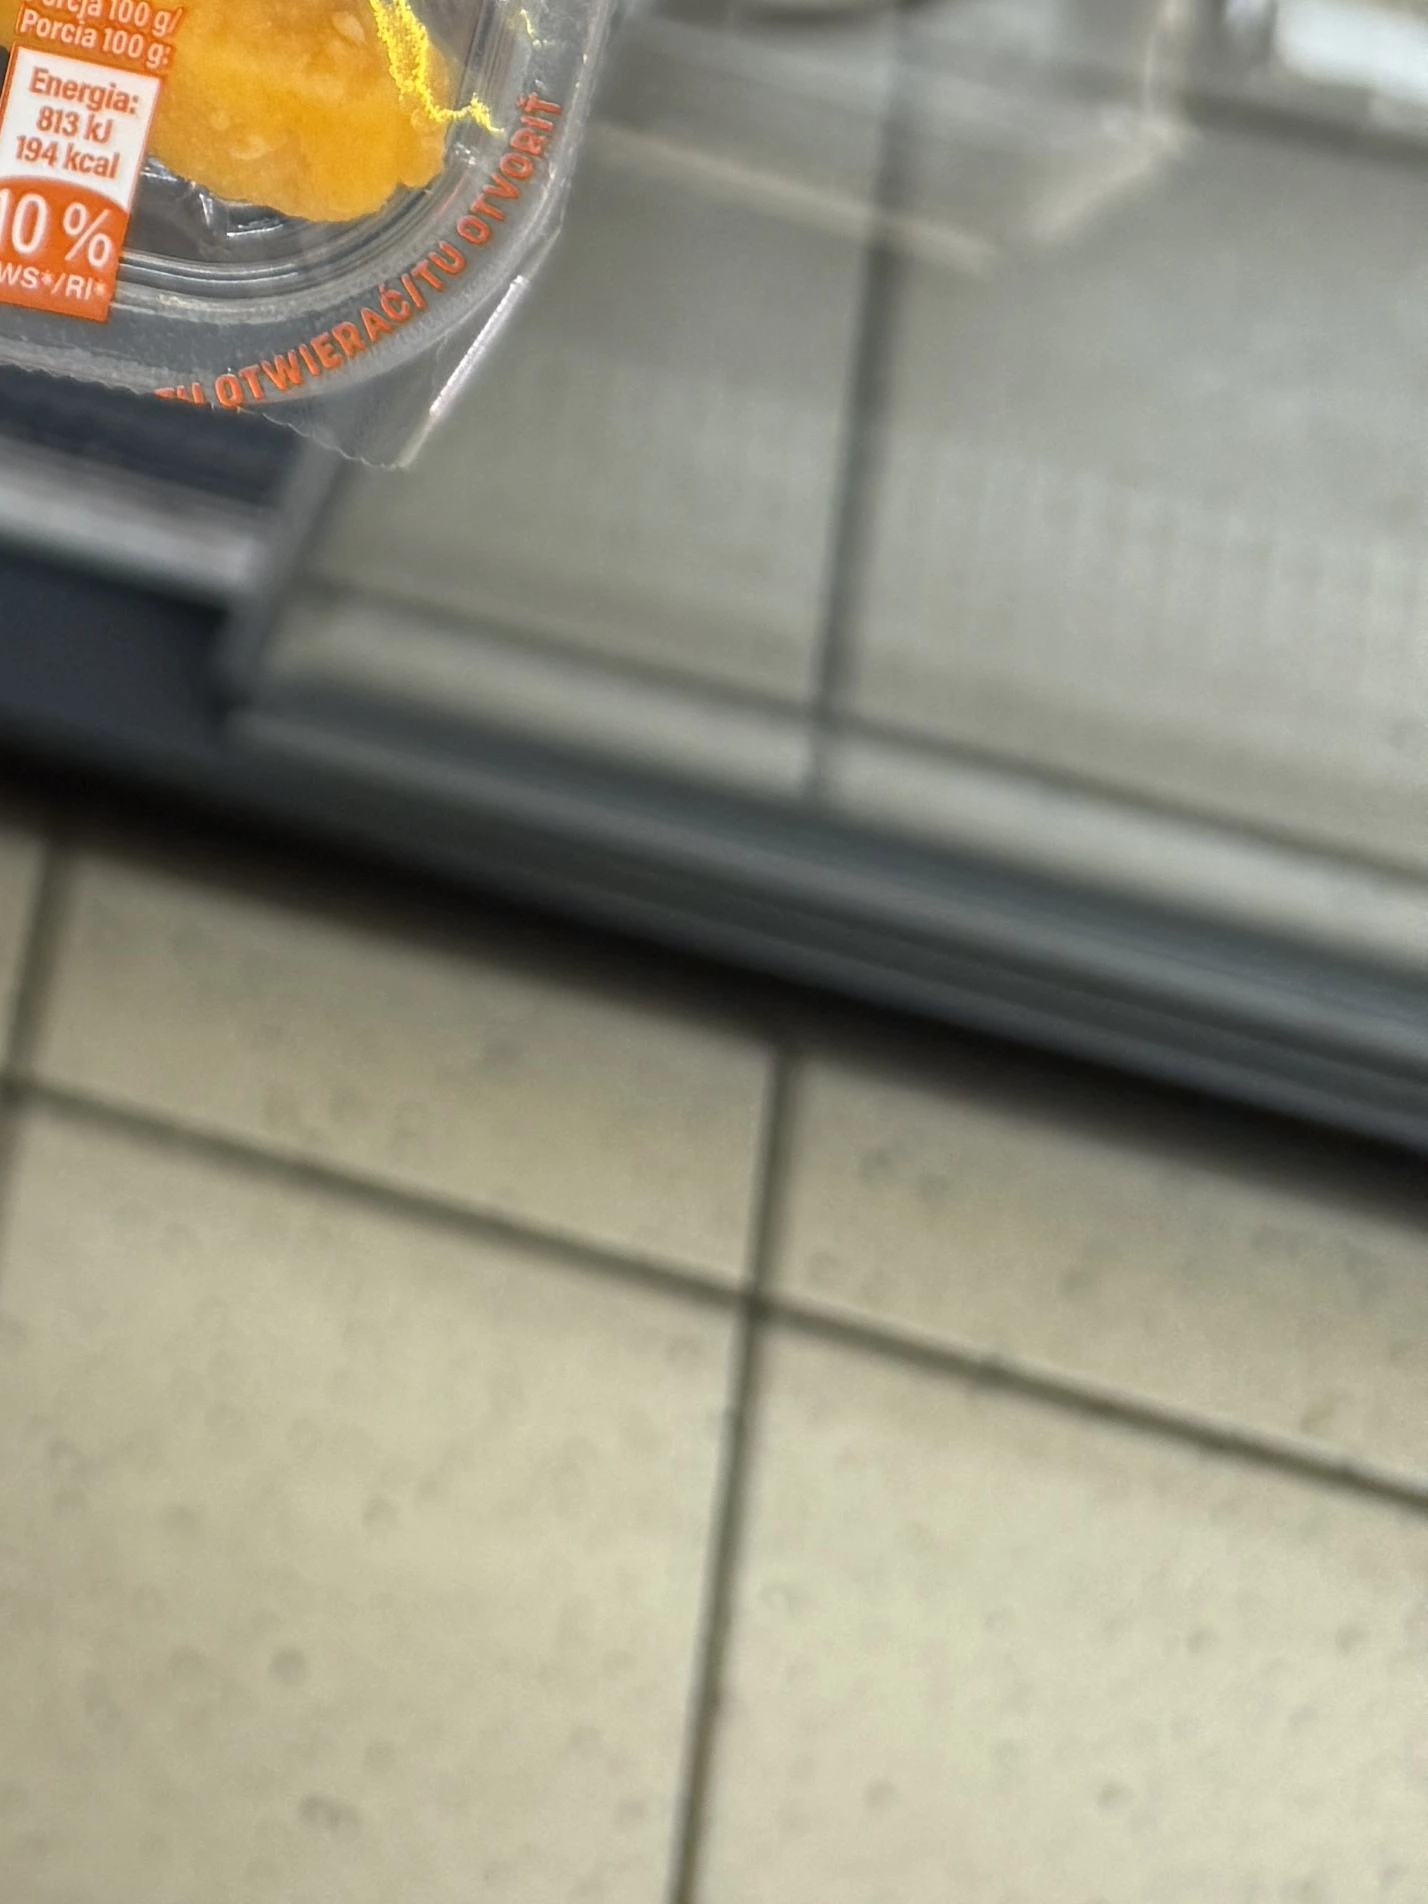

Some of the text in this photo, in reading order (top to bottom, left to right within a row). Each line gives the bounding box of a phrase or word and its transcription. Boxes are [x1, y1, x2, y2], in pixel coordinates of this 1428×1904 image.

[19, 10, 171, 69] Porcia 100 g:
[151, 7, 184, 35] g/
[28, 65, 141, 115] Energia:
[36, 105, 113, 144] 813 kJ
[15, 134, 121, 180] 194 kcal
[62, 200, 112, 269] %
[214, 240, 467, 410] OTWIERAĆ/TU
[456, 89, 564, 246] OTVORIŤ
